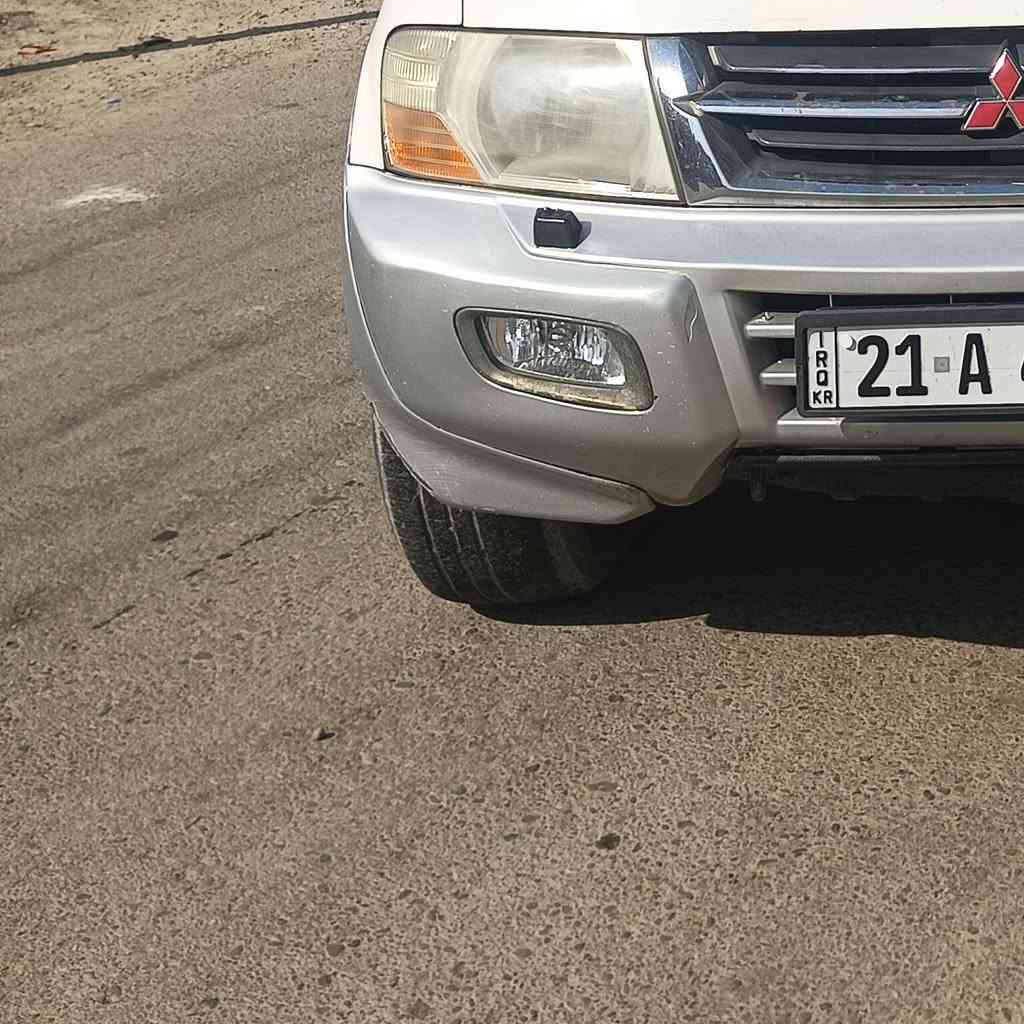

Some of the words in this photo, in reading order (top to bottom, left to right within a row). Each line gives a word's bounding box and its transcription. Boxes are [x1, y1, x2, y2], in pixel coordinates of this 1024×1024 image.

[857, 334, 928, 397] 21
[958, 333, 993, 395] A
[813, 390, 833, 404] KR
